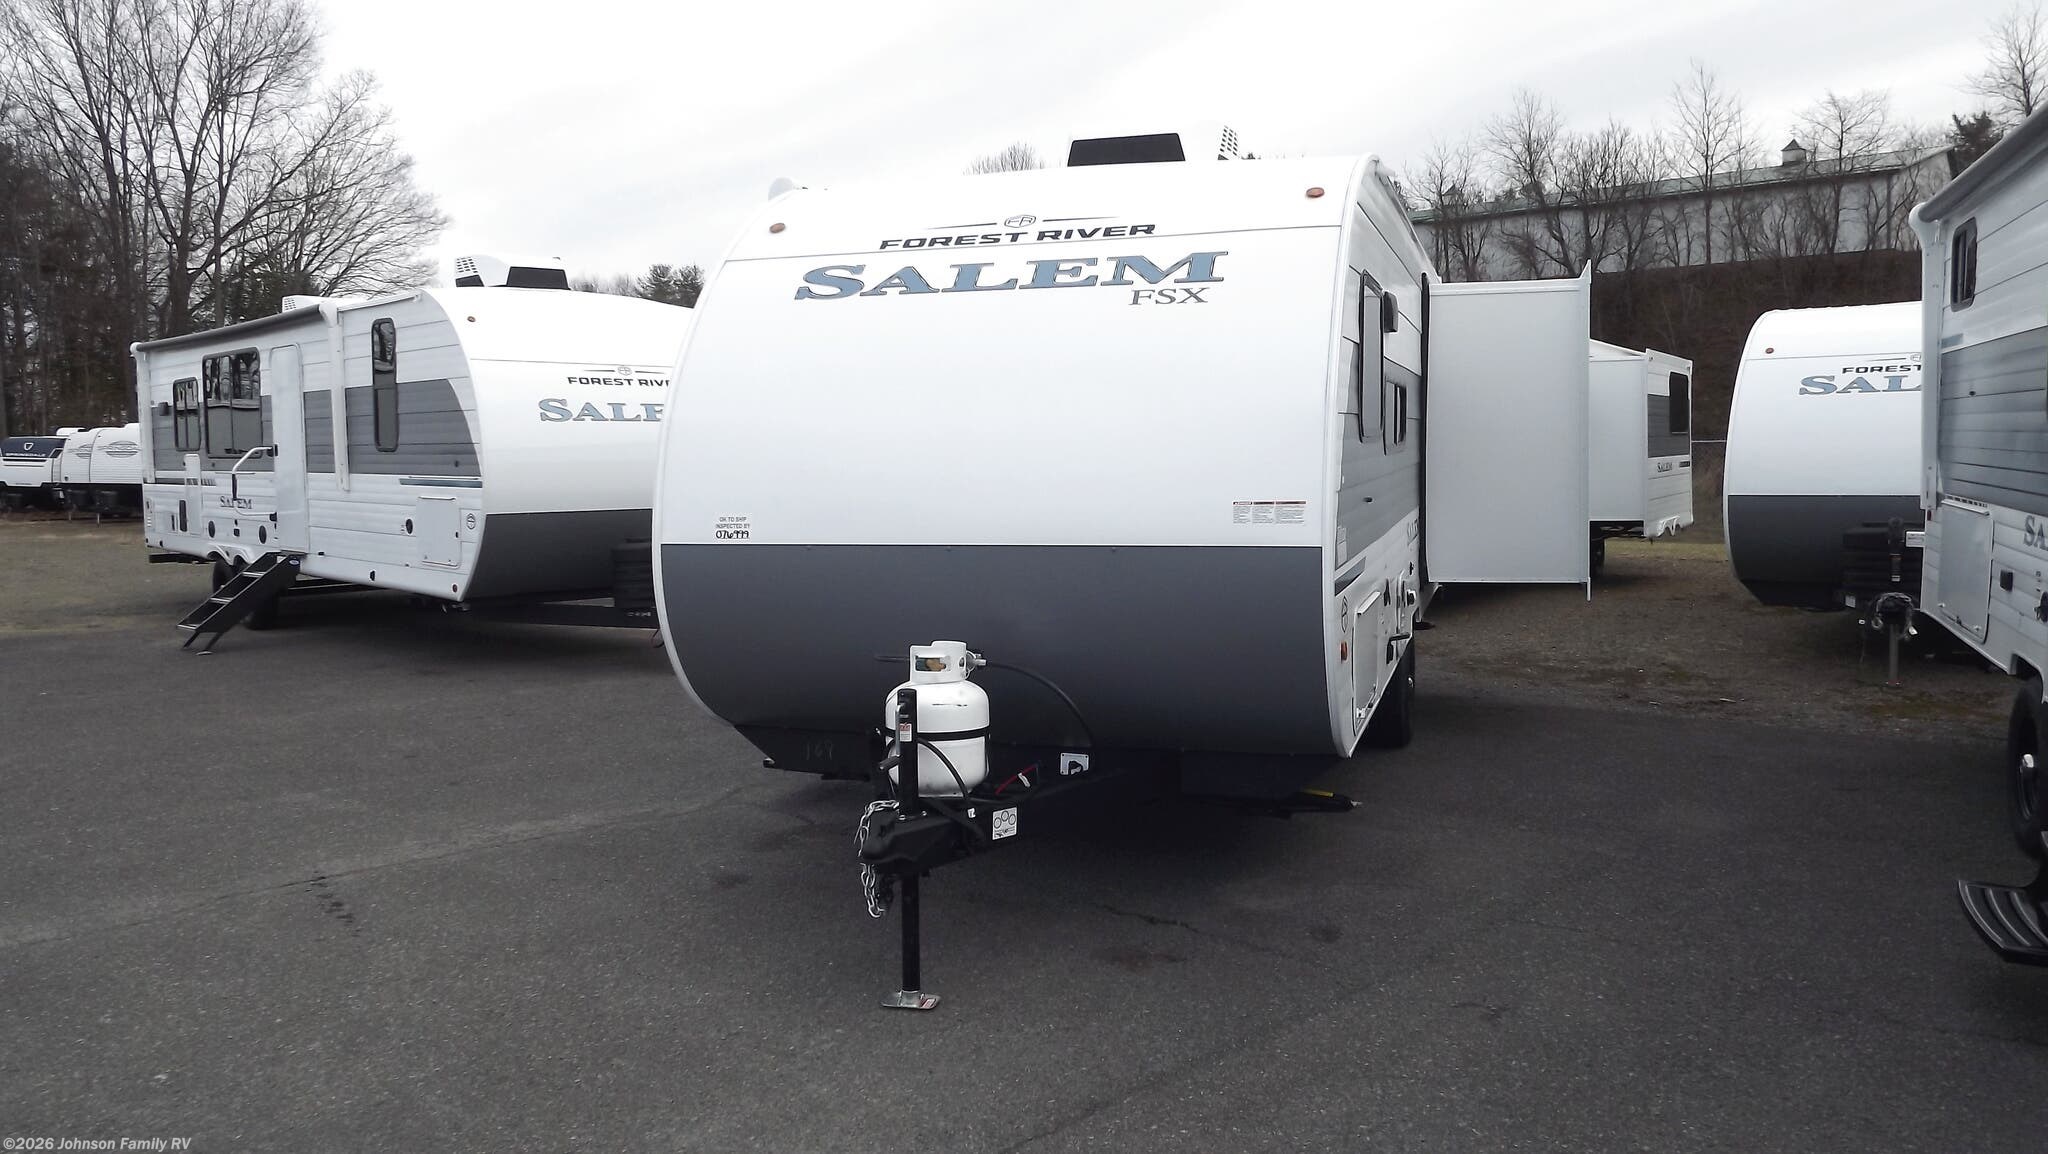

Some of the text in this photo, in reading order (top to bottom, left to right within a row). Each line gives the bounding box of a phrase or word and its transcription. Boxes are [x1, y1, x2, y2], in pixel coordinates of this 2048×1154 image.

[879, 223, 1156, 250] FOREST RIVER
[794, 250, 1229, 300] SALEM
[1128, 287, 1211, 306] FSX
[567, 376, 670, 388] FOREST RIV
